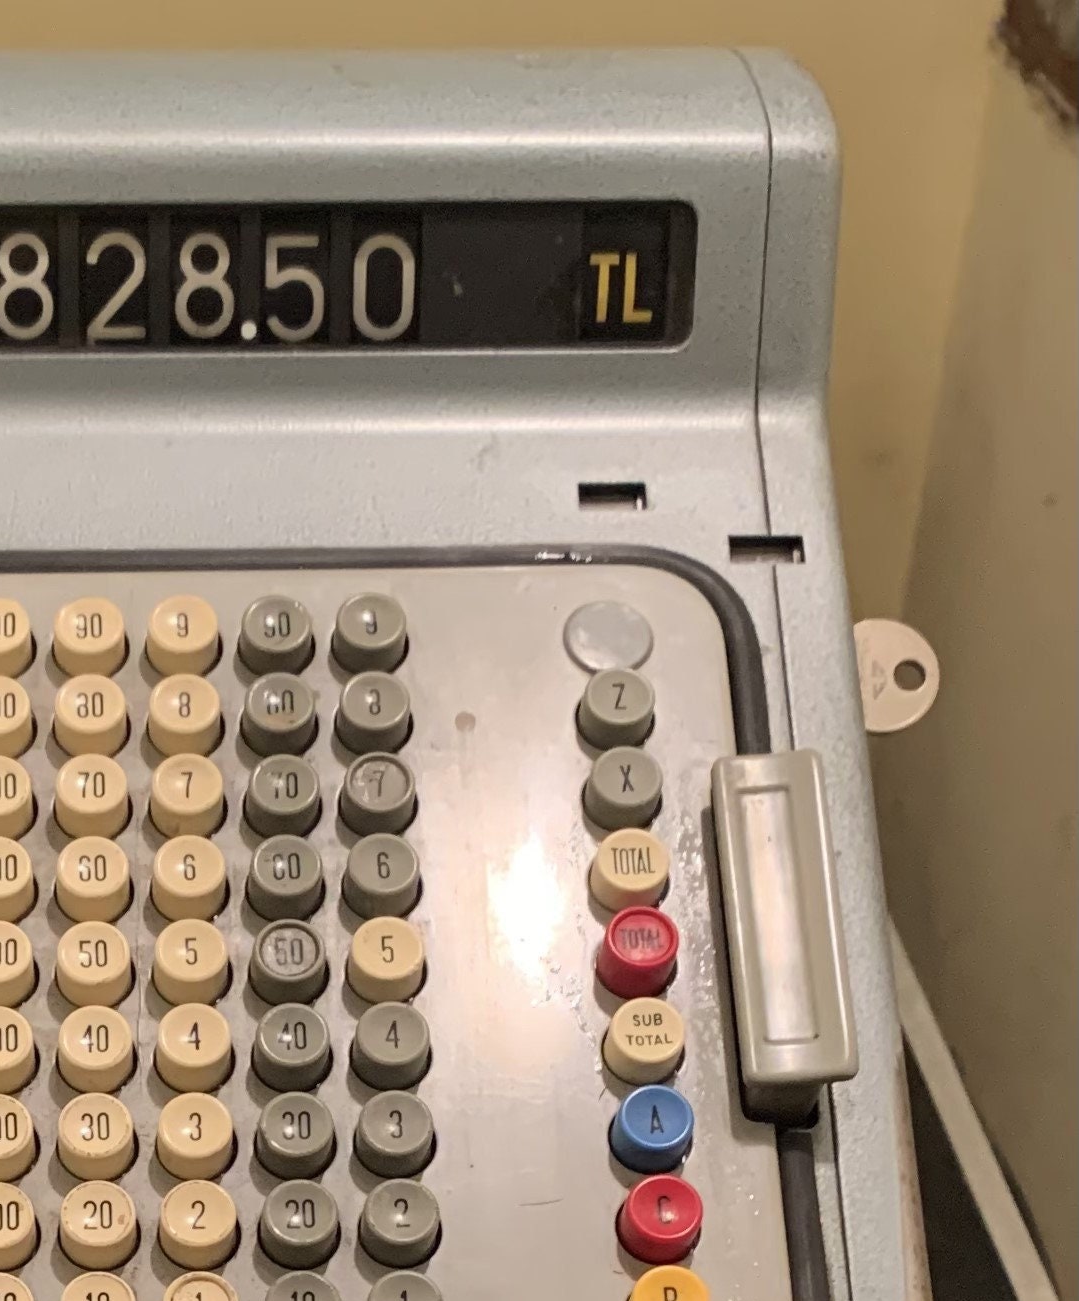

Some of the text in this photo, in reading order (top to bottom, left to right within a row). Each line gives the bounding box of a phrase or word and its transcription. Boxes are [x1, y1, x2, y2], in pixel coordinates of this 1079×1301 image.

[589, 252, 653, 324] TL
[75, 612, 103, 639] 90
[176, 612, 189, 638] 9
[178, 691, 191, 718] 8
[611, 682, 627, 711] Z
[76, 771, 106, 799] 70
[180, 771, 193, 799] 7
[370, 770, 385, 798] 7
[619, 763, 635, 793] X
[182, 853, 197, 881] 6
[376, 851, 391, 879] 6
[610, 846, 656, 876] TOTAL
[78, 939, 108, 968] 50
[184, 937, 198, 965] 5
[274, 937, 305, 966] 50
[380, 935, 395, 964] 5
[631, 1012, 664, 1027] SUB
[79, 1024, 110, 1053] 40
[186, 1022, 201, 1051] 4
[278, 1021, 308, 1051] 40
[385, 1020, 401, 1049] 4
[625, 1033, 674, 1047] TOTAL
[80, 1112, 110, 1141] 30
[188, 1111, 202, 1141] 3
[388, 1109, 403, 1139] 3
[649, 1104, 664, 1134] A
[82, 1200, 113, 1230] 20
[190, 1200, 206, 1230] 2
[285, 1198, 316, 1229] 20
[394, 1197, 411, 1228] 2
